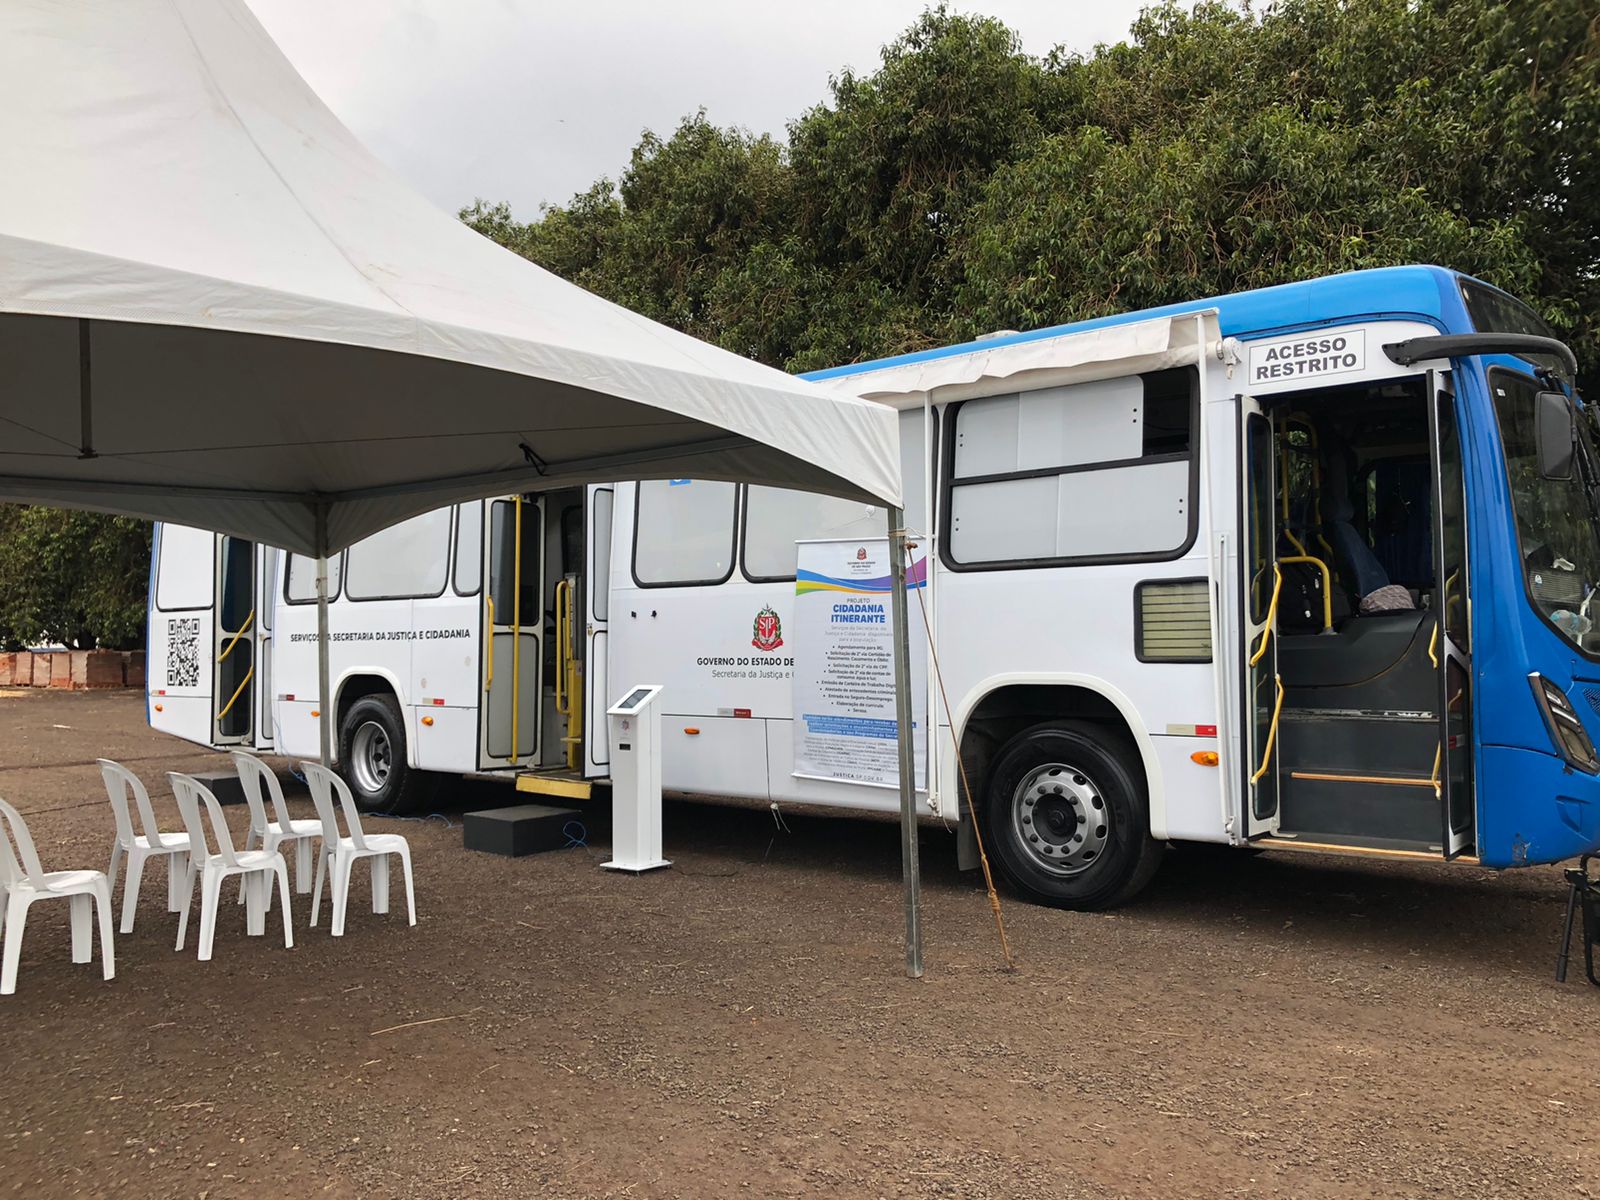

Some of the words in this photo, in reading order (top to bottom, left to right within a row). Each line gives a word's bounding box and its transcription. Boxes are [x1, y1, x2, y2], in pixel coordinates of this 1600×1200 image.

[1265, 337, 1347, 362] ACESSO
[1256, 353, 1357, 380] RESTRITO
[833, 604, 884, 613] CIDADANIA
[831, 614, 886, 623] ITINERANTE
[290, 633, 319, 643] SERVIÇOS
[333, 632, 374, 641] SECRETARIA
[375, 632, 386, 640] DA
[387, 631, 417, 642] JUSTIÇA
[419, 630, 424, 640] E
[425, 629, 470, 639] CIDADANIA
[696, 658, 735, 666] GOVERNO
[737, 658, 749, 666] DO
[751, 658, 782, 666] ESTADO
[784, 658, 794, 666] DE
[712, 670, 746, 678] Secretaria
[748, 670, 757, 678] da
[759, 670, 783, 680] Justiça
